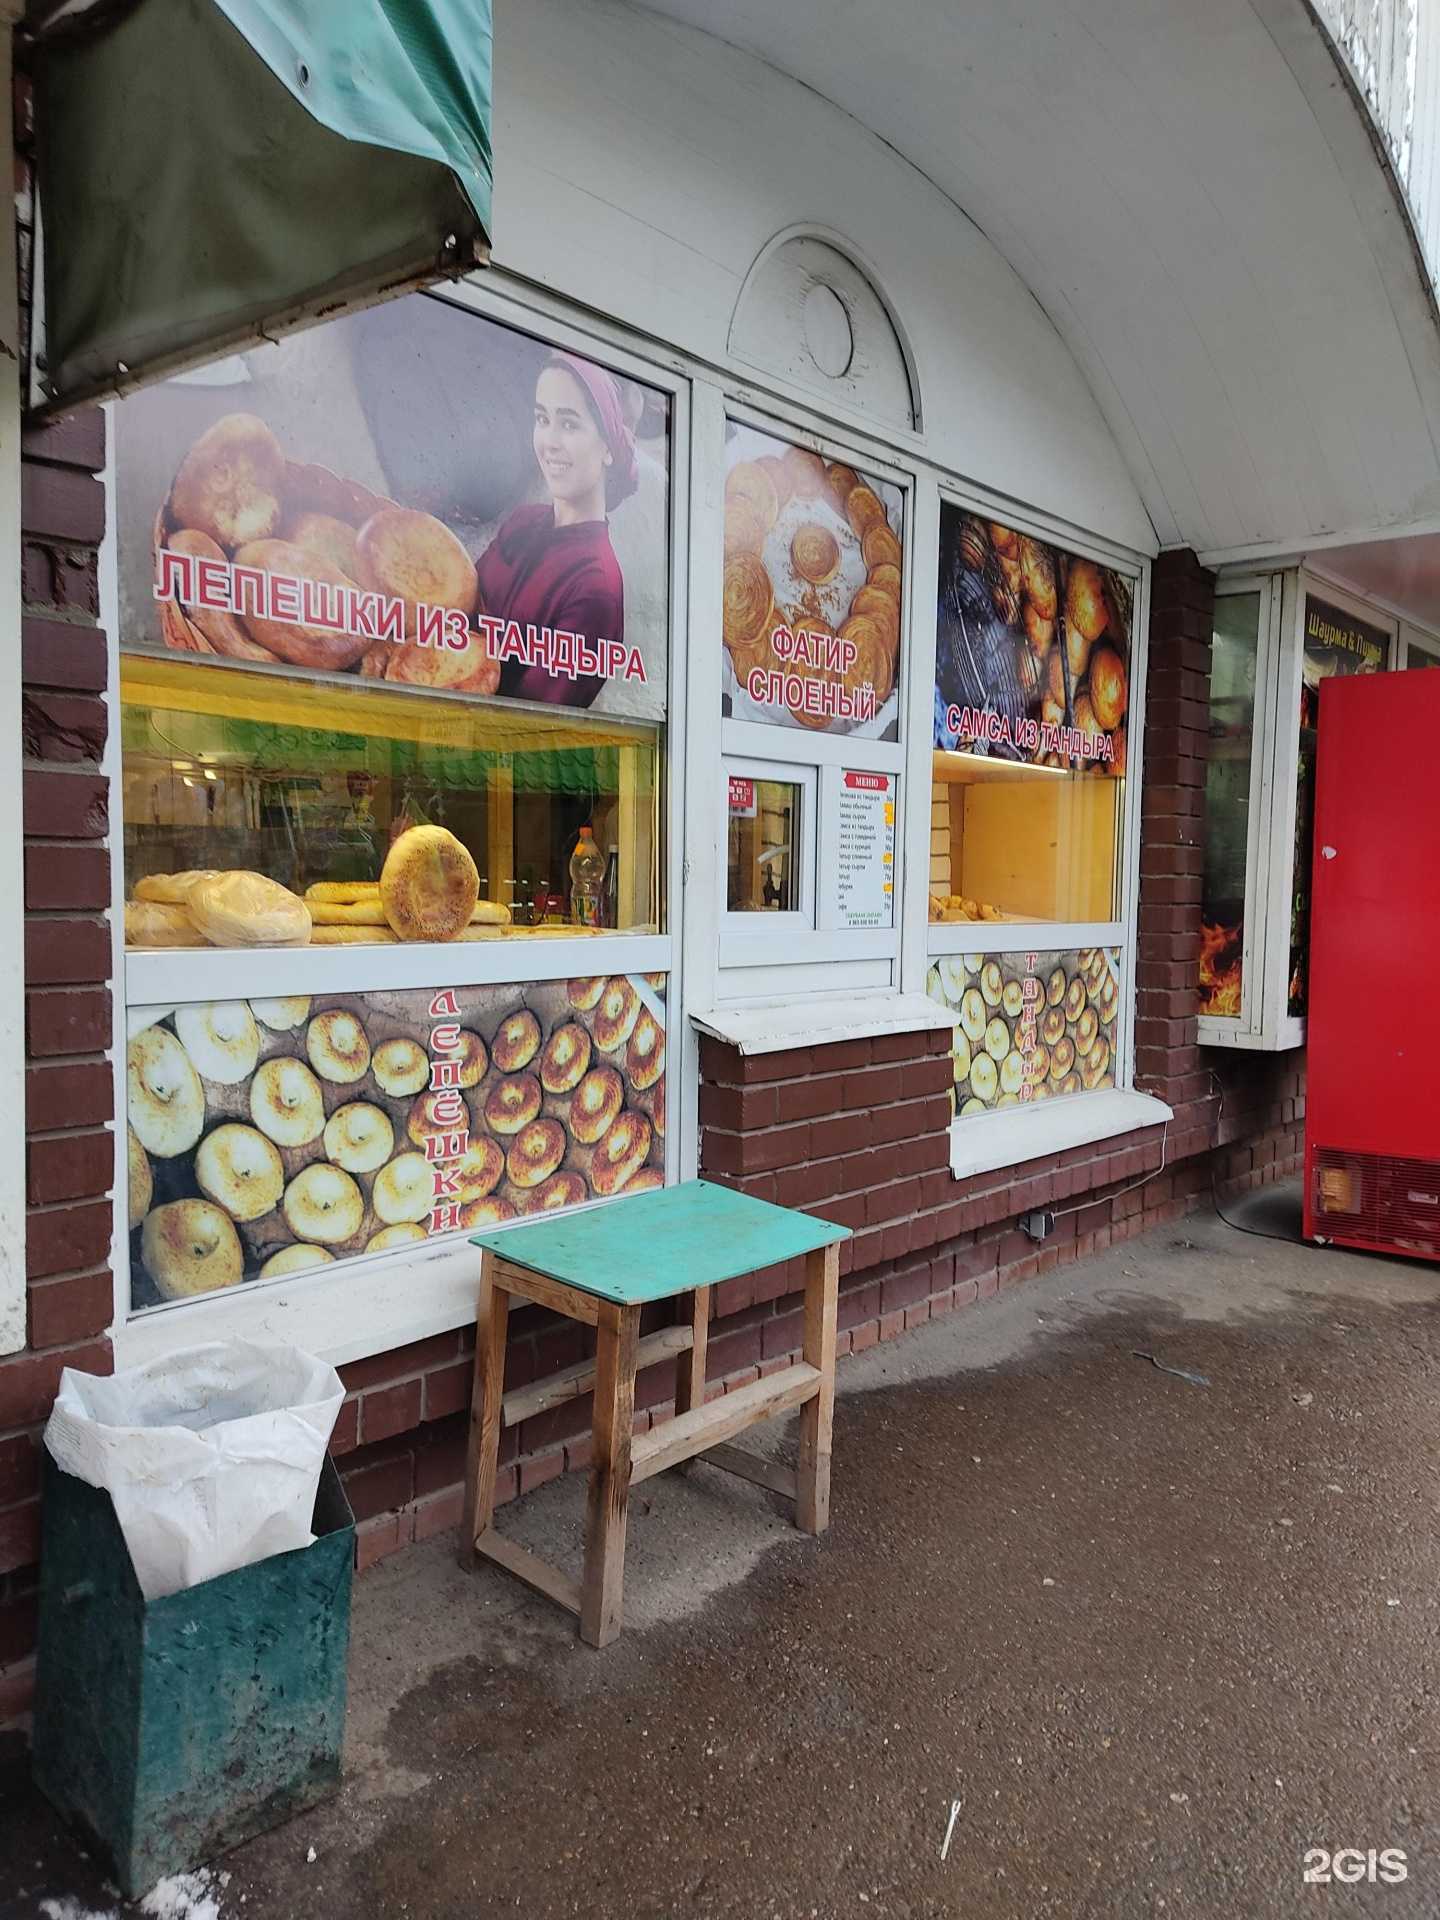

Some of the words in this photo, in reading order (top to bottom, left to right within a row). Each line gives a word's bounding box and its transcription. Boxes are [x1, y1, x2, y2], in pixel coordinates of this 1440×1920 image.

[153, 549, 406, 643] ЛЕПЕШКИ
[417, 602, 470, 652] ИЗ
[480, 614, 648, 684] ТАНДЫРА
[1308, 613, 1347, 647] Шаурма
[771, 624, 858, 673] ФАТИР
[748, 667, 877, 722] СЛОЕНЫЙ
[946, 703, 1012, 745] САМСА
[1015, 716, 1039, 749] ИЗ
[1040, 721, 1115, 762] ТАНДЫРА
